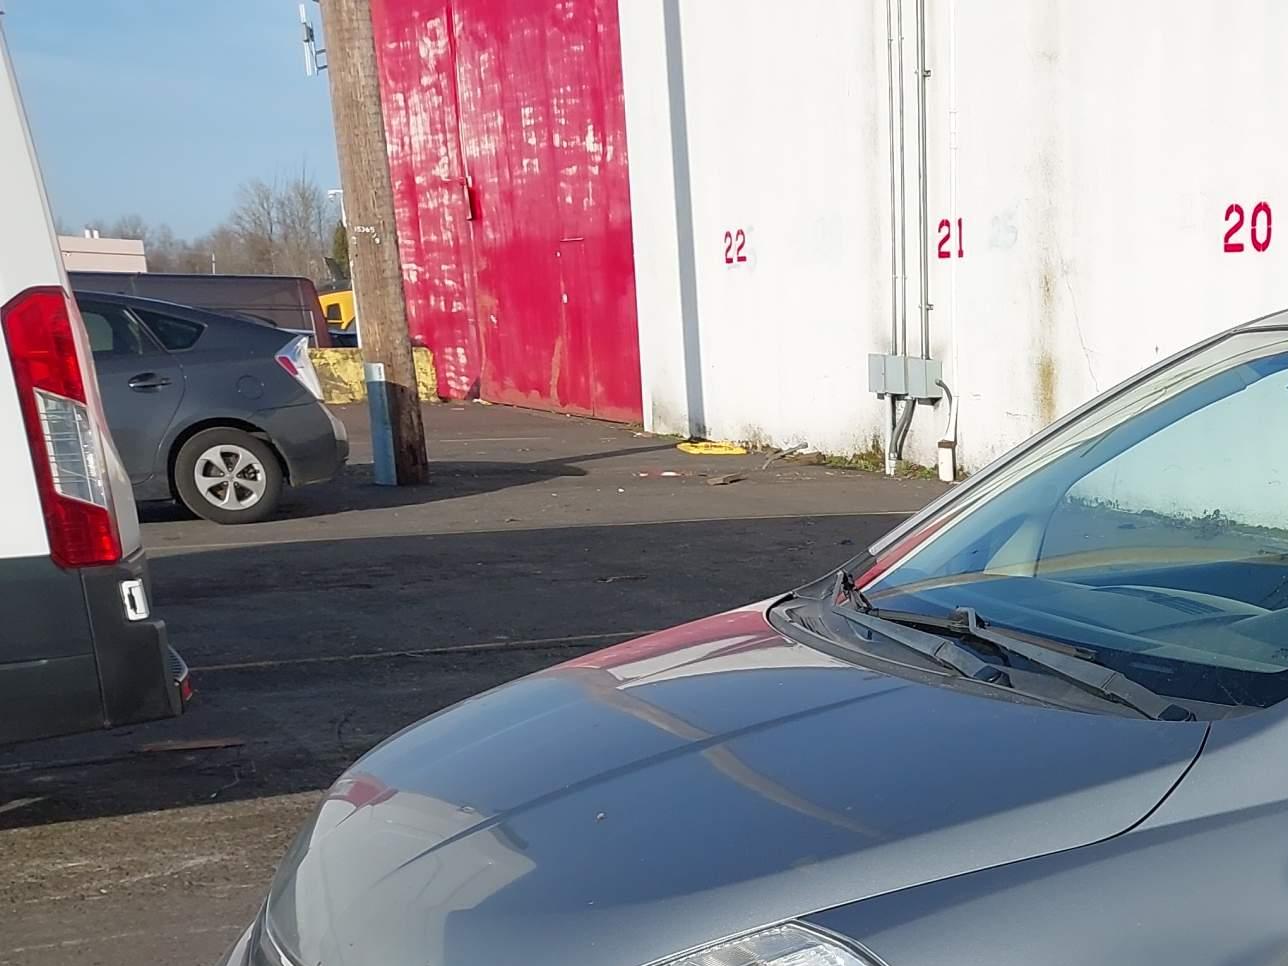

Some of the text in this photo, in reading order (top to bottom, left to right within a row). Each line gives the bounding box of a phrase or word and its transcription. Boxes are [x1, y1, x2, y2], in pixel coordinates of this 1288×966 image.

[724, 229, 748, 265] 22
[937, 218, 964, 259] 21
[1223, 201, 1273, 254] 20
